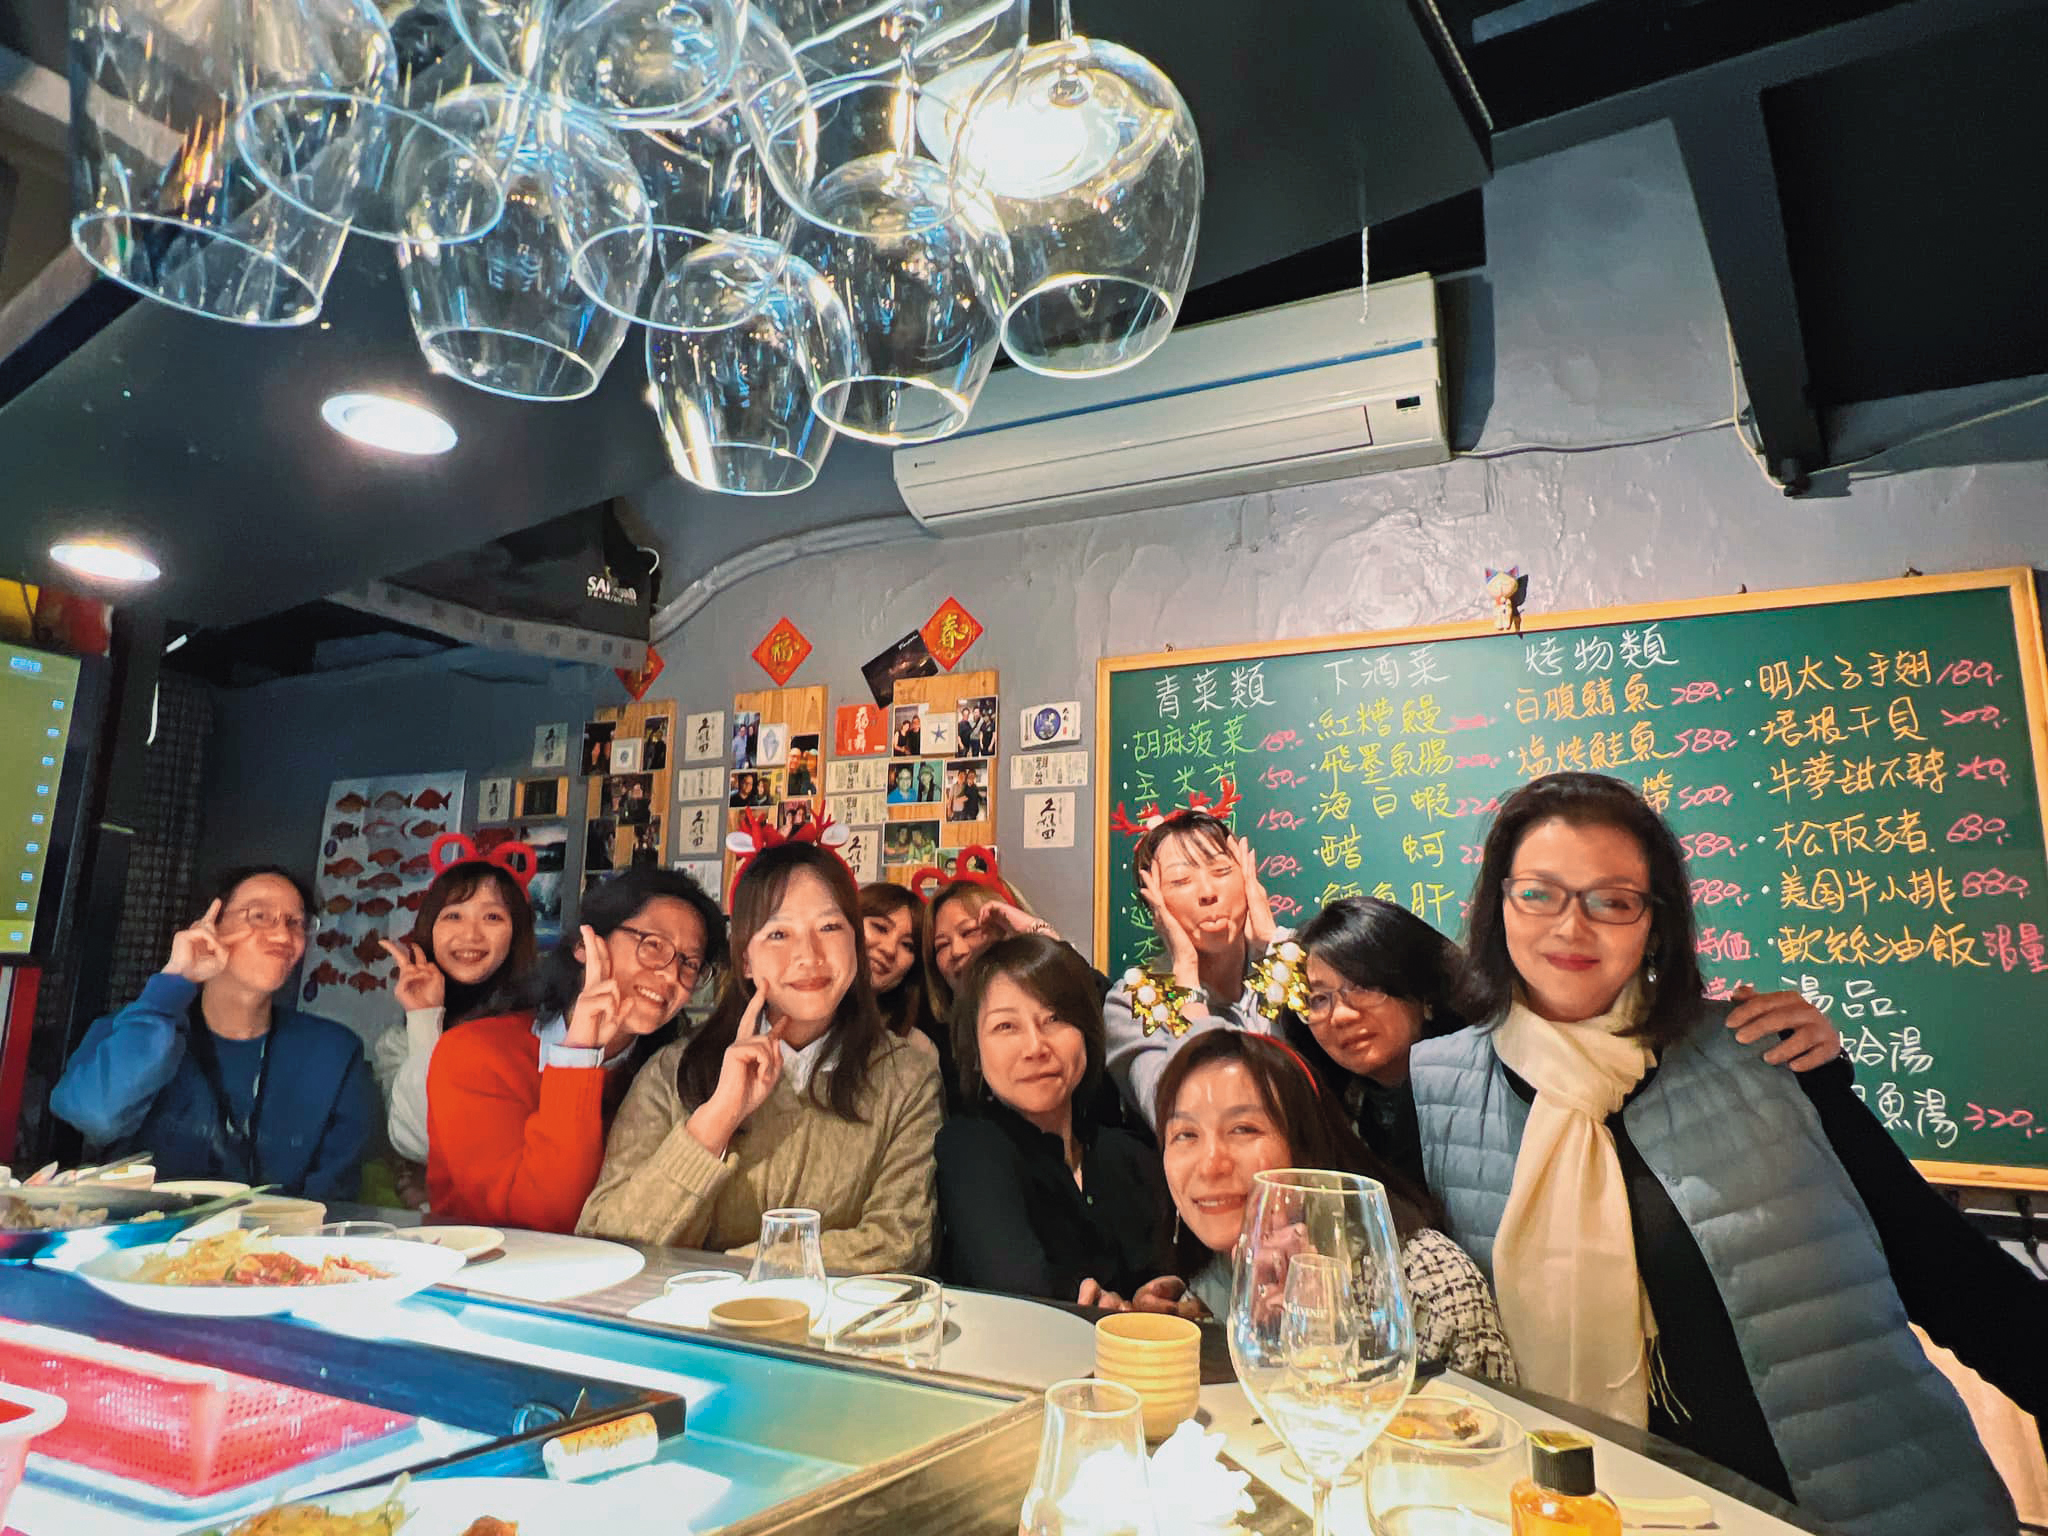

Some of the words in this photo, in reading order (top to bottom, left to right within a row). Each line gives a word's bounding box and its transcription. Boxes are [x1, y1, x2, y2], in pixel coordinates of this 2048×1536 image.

[771, 631, 800, 663] 福
[941, 614, 970, 650] 春
[1525, 624, 1679, 676] 烤物類
[1155, 661, 1277, 720] 青菜類
[1324, 646, 1450, 695] 下酒菜
[1515, 672, 1663, 724] 白腹鯖魚
[1761, 696, 1928, 747] 培根干貝
[1133, 714, 1256, 764] 胡麻菠菜
[1778, 923, 1991, 967] 軟絲油飯
[1982, 923, 2048, 973] 限量
[1851, 1082, 1959, 1149] 魚湯
